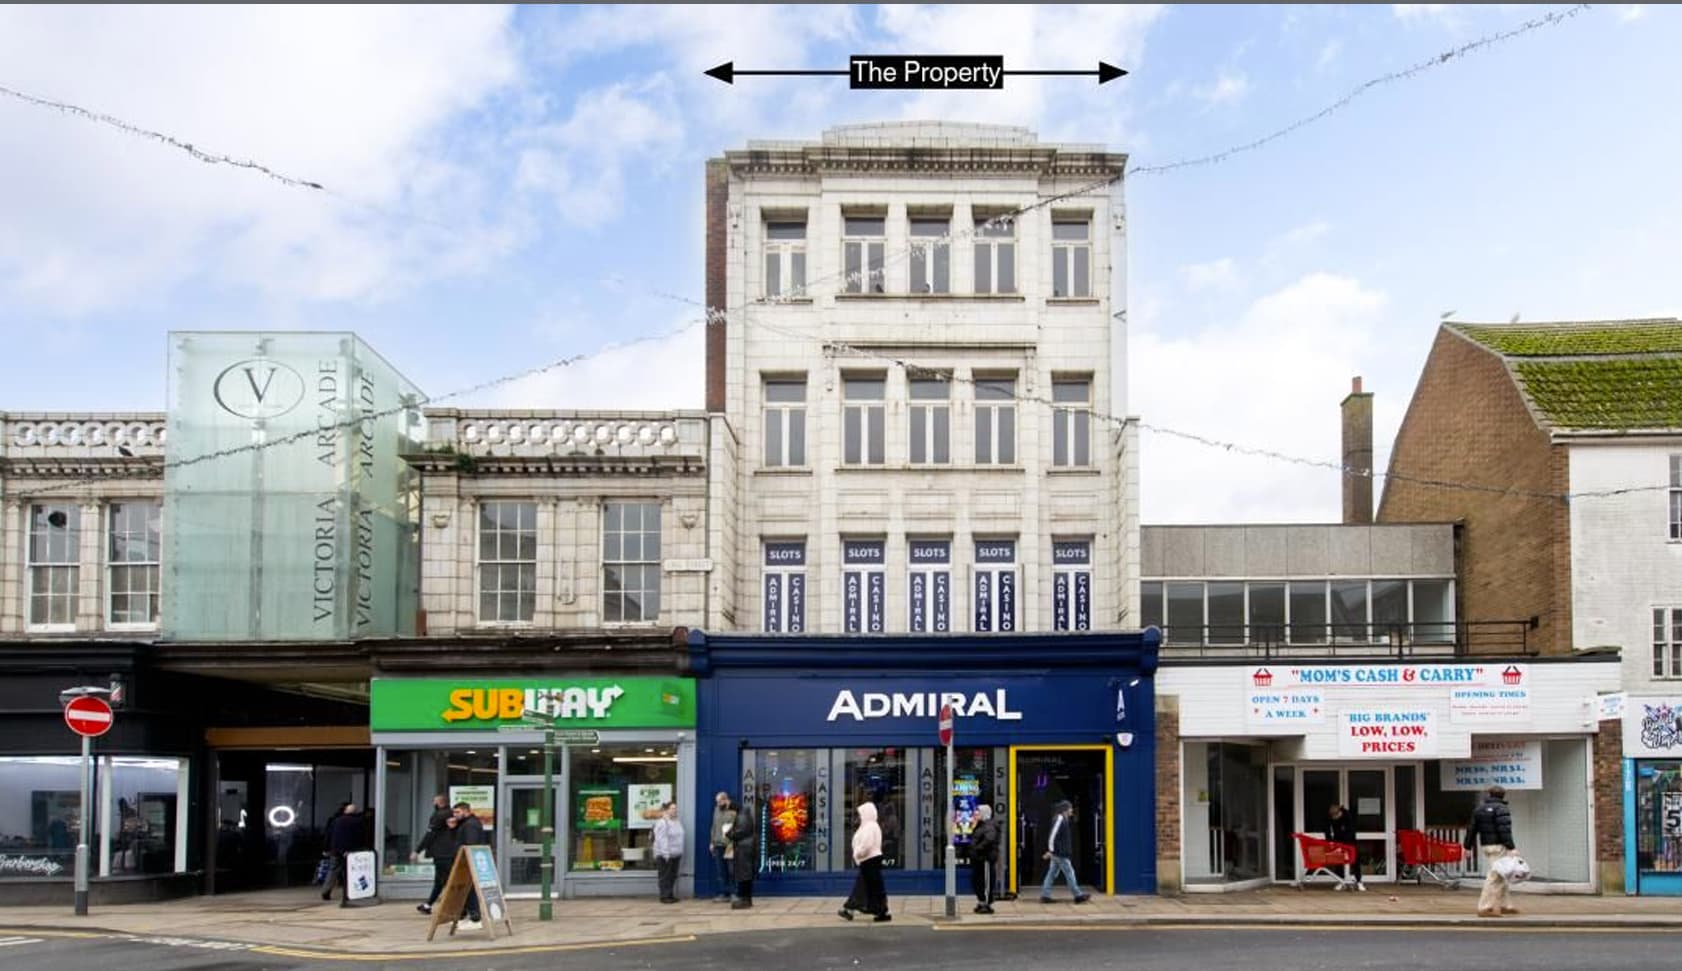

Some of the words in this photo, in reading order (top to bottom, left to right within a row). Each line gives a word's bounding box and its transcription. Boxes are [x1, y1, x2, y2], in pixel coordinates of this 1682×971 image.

[243, 366, 276, 403] V
[317, 360, 337, 468] ARCADE
[360, 370, 376, 479] ARCADE
[313, 497, 336, 623] VICTORIA
[356, 509, 373, 627] VICTORIA
[769, 550, 801, 560] SLOTS
[848, 548, 880, 558] SLOTS
[914, 548, 946, 558] SLOTS
[979, 547, 1011, 557] SLOTS
[1055, 548, 1087, 558] SLOTS
[768, 577, 778, 632] ADMIRAL
[791, 577, 801, 632] CASINO
[848, 576, 858, 632] ADMIRAL
[871, 576, 881, 631] CASINO
[913, 576, 923, 631] ADMIRAL
[936, 575, 946, 631] CASINO
[978, 575, 988, 631] ADMIRAL
[1001, 575, 1012, 631] CASINO
[1055, 577, 1066, 631] ADMIRAL
[1077, 576, 1088, 631] CASINO
[1355, 669, 1398, 682] CASH
[1402, 668, 1416, 682] &
[826, 689, 1023, 721] ADMIRAL
[1251, 695, 1281, 704] OPEN
[1283, 696, 1289, 704] 7
[1292, 695, 1321, 703] DAYS
[1454, 691, 1496, 699] OPENING
[1265, 710, 1274, 719] A
[1276, 710, 1308, 718] WEEK
[1350, 725, 1388, 738] LOW,
[1391, 725, 1429, 738] LOW,
[1361, 741, 1416, 753] PRICES
[817, 767, 828, 853] CASINO
[921, 767, 933, 853] ADMIRAL
